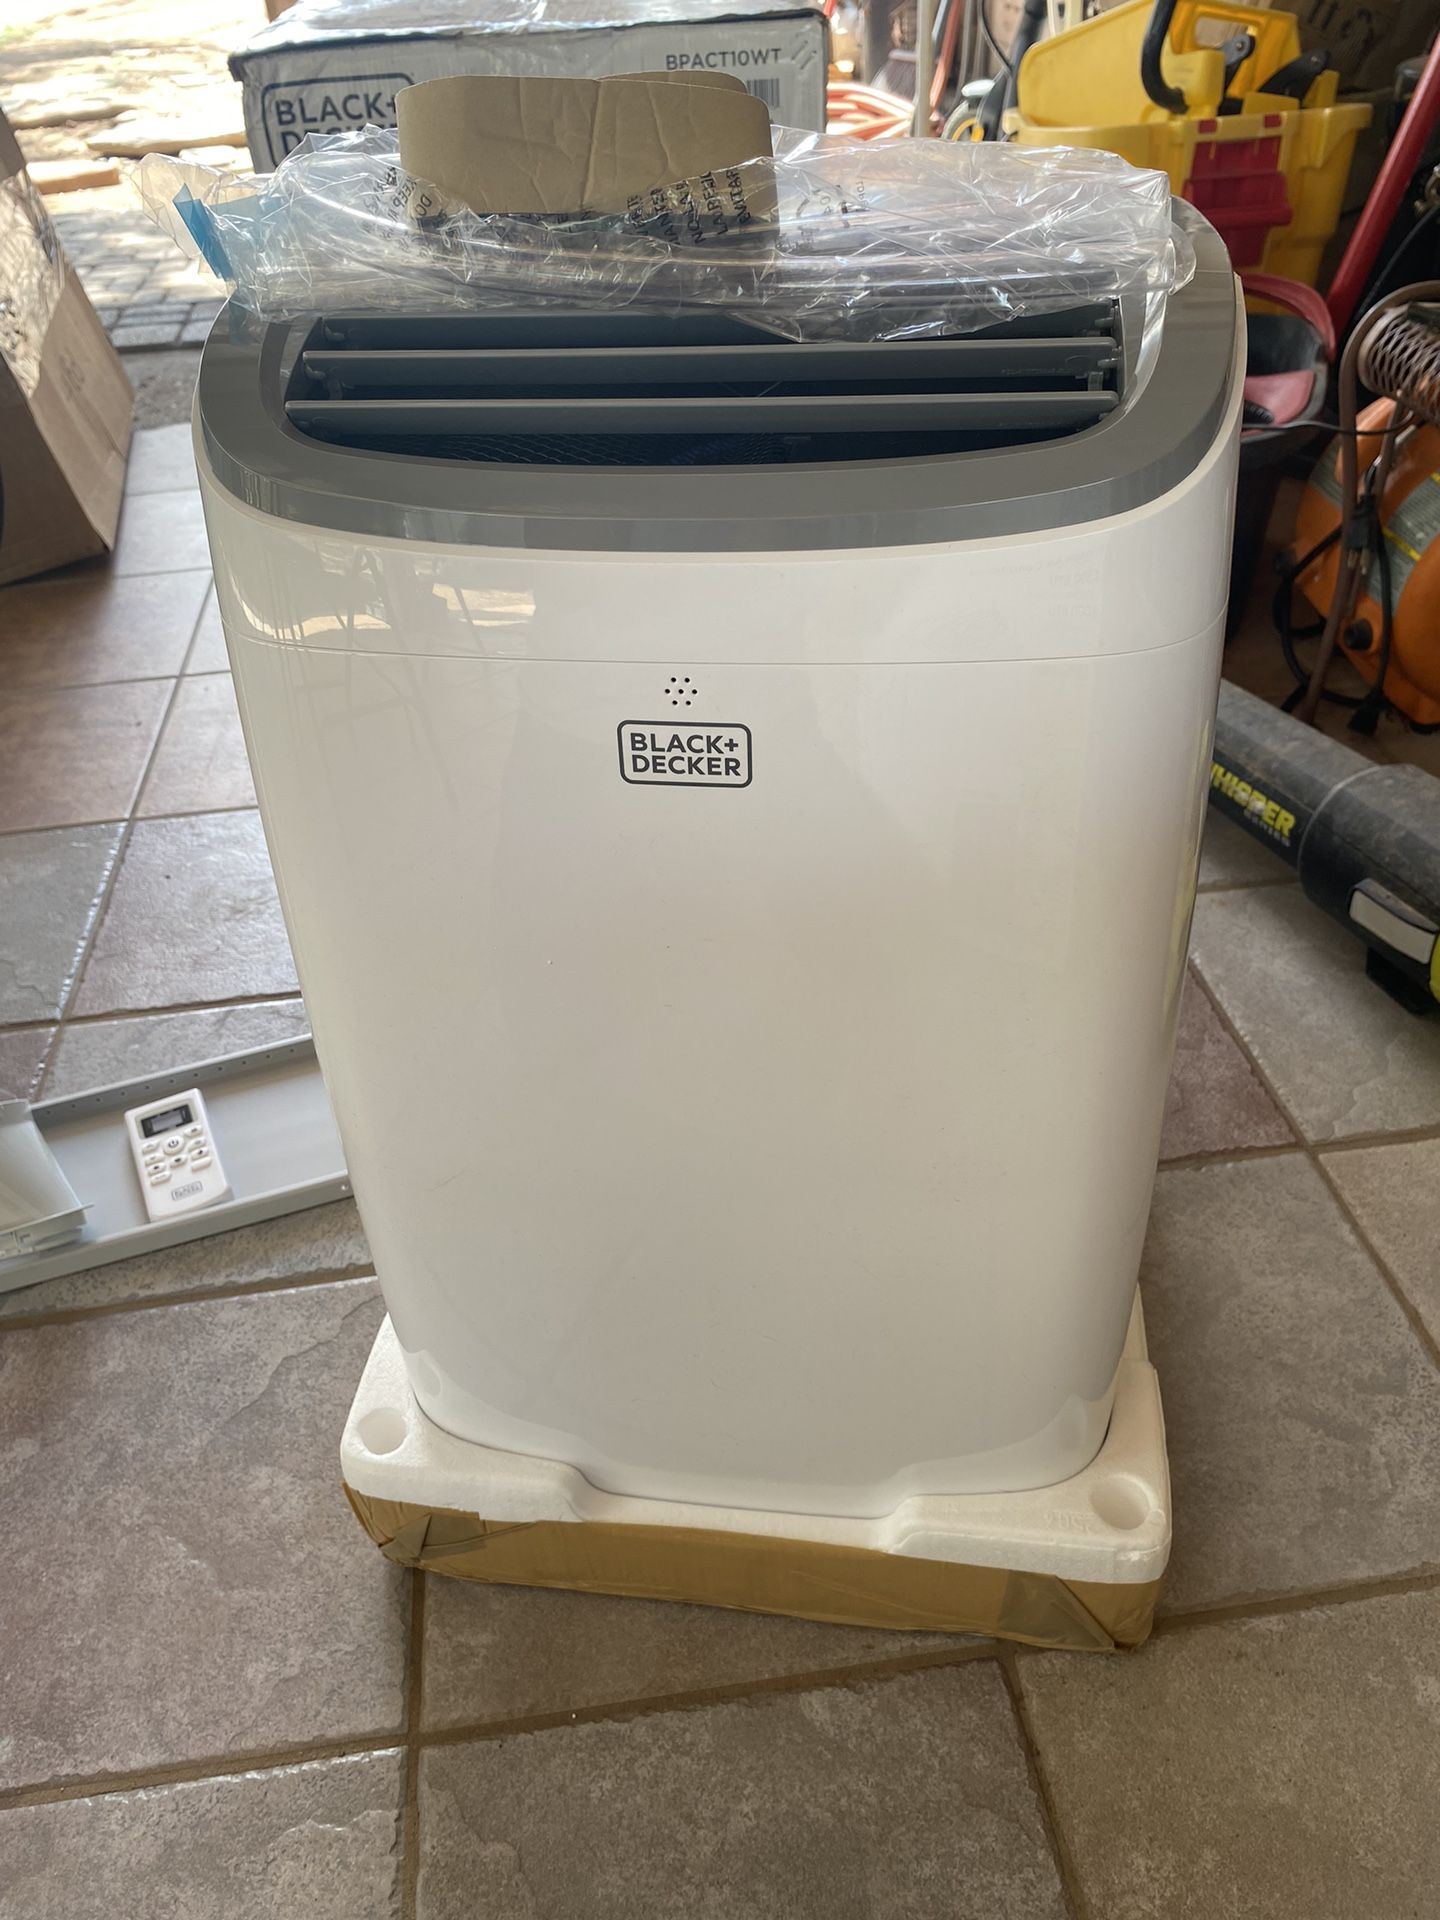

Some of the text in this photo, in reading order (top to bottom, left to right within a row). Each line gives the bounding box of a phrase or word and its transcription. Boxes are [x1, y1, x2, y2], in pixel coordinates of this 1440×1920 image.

[666, 48, 781, 70] BPACT10WT
[630, 732, 739, 754] BLACK+
[632, 754, 741, 777] DECKER
